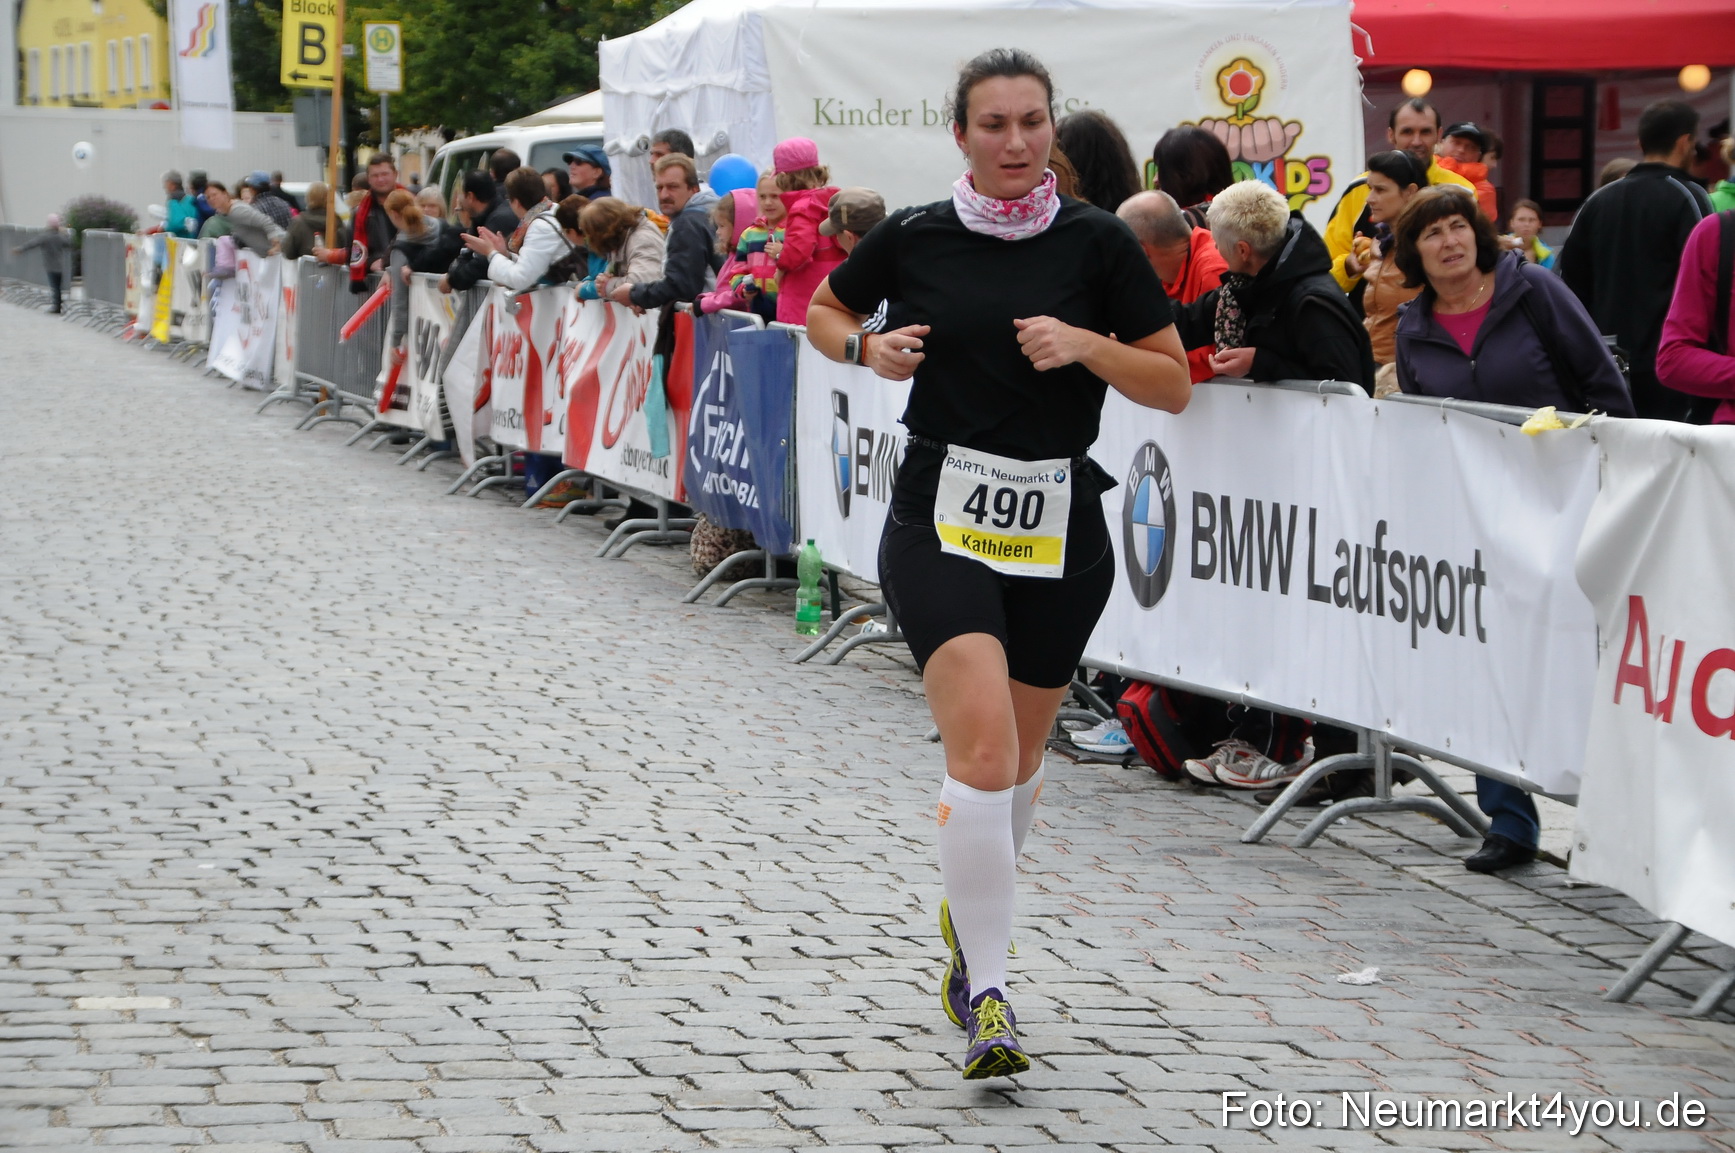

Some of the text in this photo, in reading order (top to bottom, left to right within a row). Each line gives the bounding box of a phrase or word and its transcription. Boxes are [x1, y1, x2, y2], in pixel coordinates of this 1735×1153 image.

[291, 0, 336, 16] Block
[298, 21, 326, 65] B
[813, 97, 912, 126] Kinder
[946, 457, 1050, 484] PARTL Neumarkt
[1128, 446, 1172, 501] BMW
[963, 483, 1045, 530] 490
[961, 533, 1034, 558] Kathleen
[1191, 491, 1487, 650] BMW Laufsport
